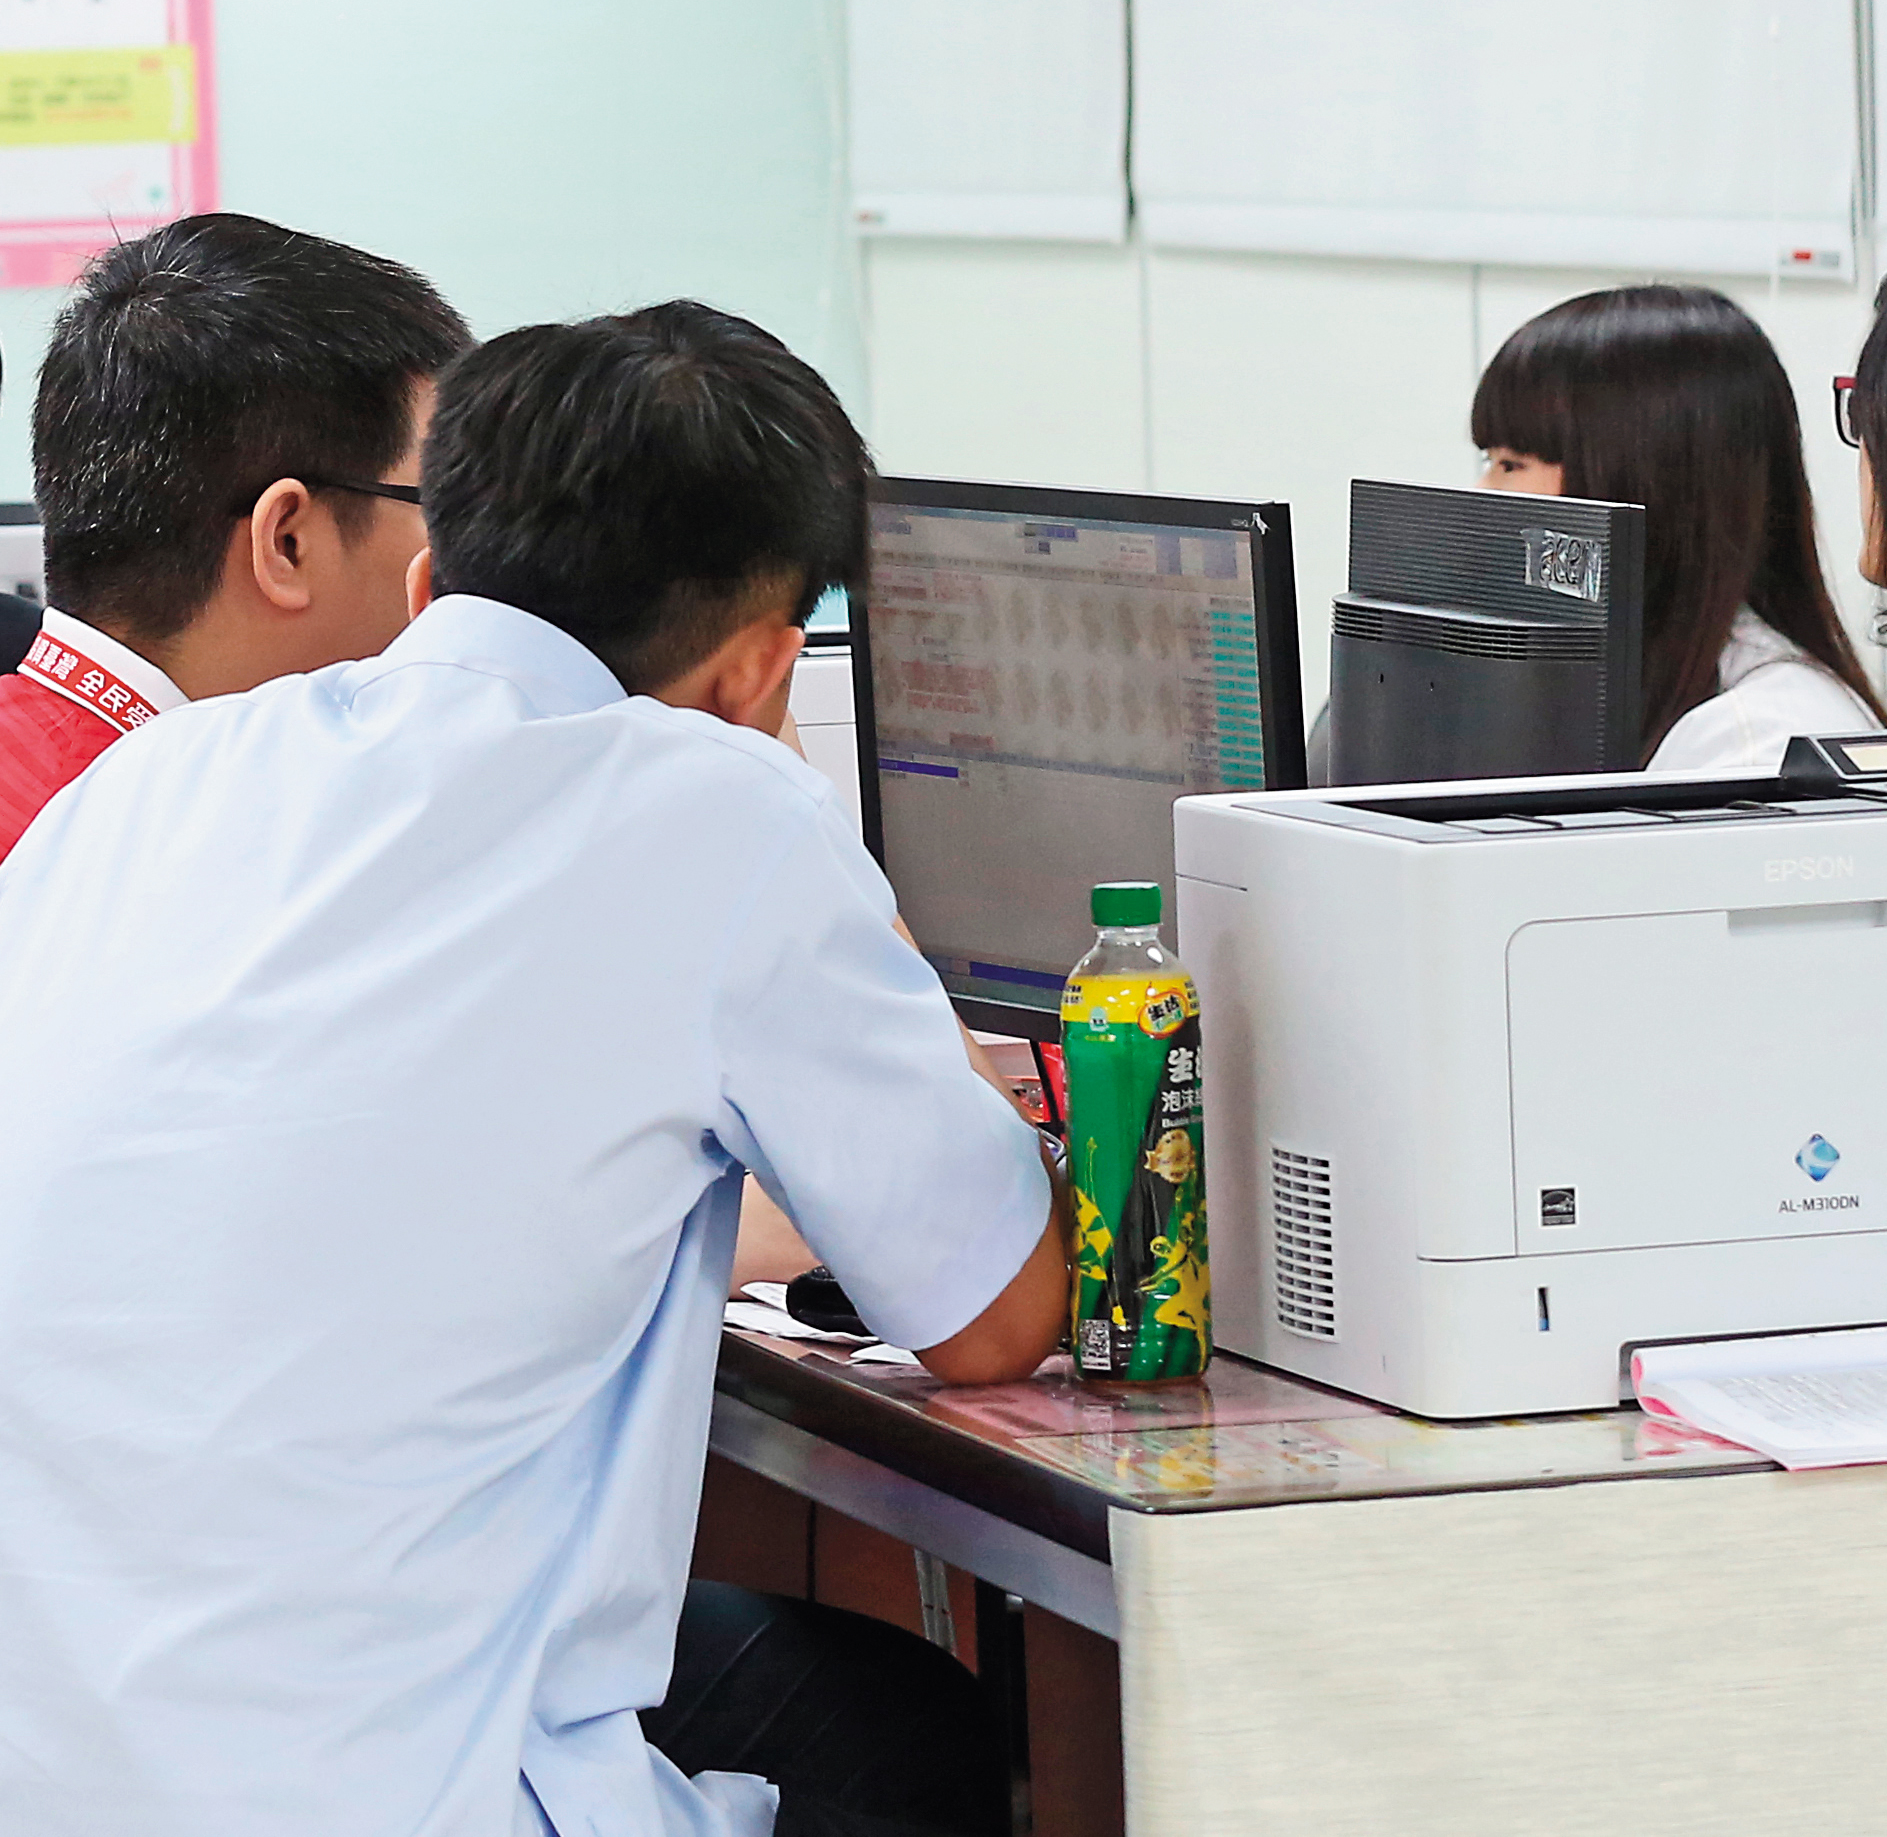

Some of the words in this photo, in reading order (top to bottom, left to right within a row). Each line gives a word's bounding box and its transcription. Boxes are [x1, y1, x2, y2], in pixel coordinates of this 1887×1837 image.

[75, 669, 154, 730] 全民受
[1763, 855, 1854, 883] EPSON
[1168, 1047, 1203, 1083] 生
[1778, 1194, 1859, 1214] AL-M310DN
